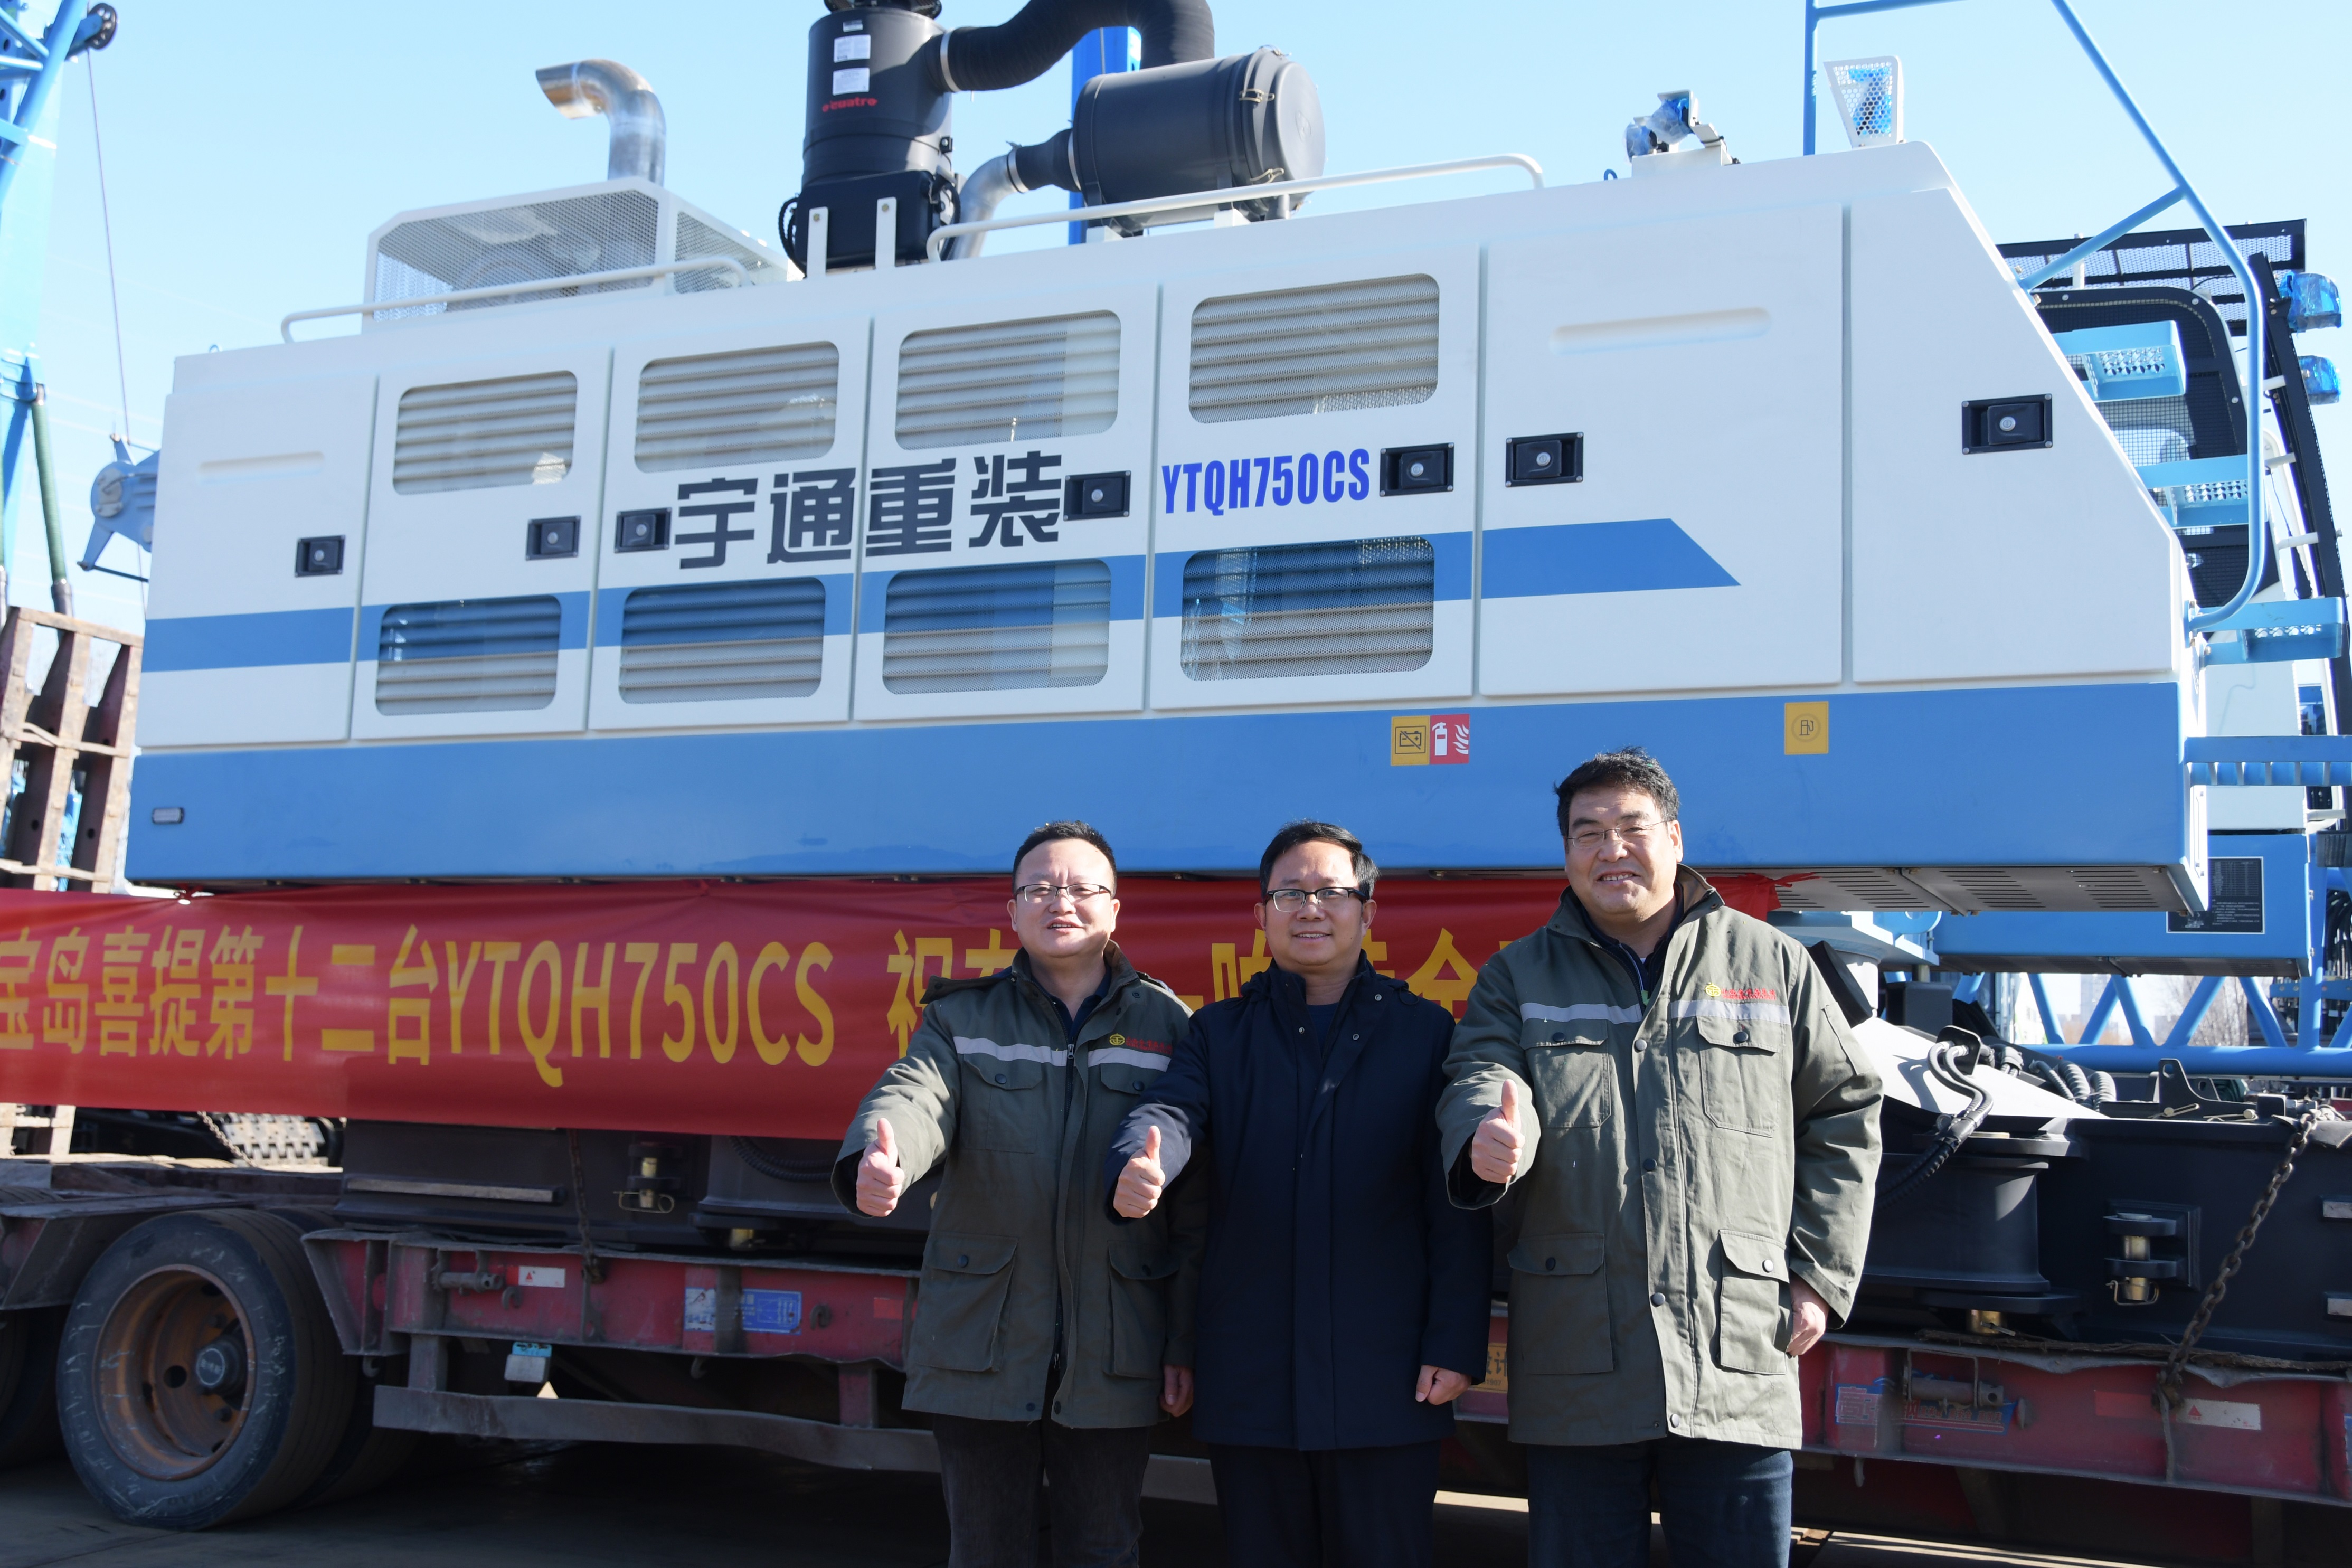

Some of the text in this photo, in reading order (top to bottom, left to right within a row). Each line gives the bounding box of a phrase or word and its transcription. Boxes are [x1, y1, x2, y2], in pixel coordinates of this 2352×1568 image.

[675, 451, 1062, 569] 宇通重装
[1162, 449, 1370, 516] YTQH750CS
